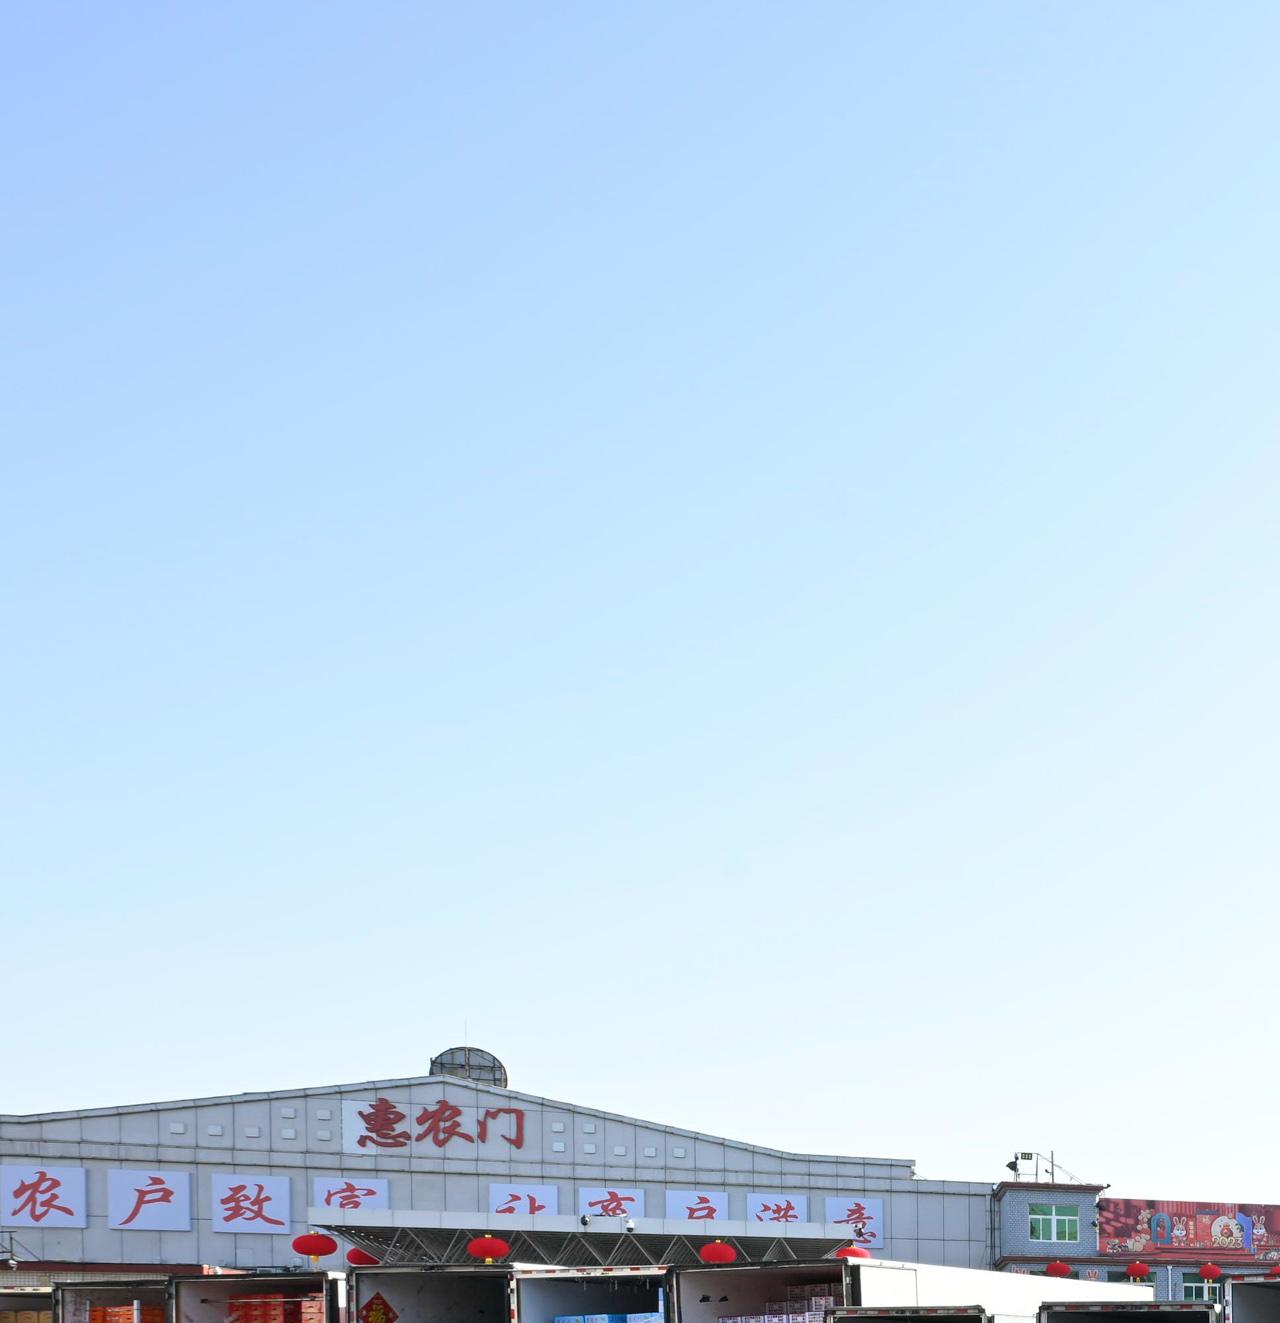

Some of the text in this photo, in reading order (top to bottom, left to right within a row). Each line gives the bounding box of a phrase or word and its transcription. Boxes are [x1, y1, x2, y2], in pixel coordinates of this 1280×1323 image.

[357, 1097, 524, 1149] 惠农门
[1212, 1237, 1243, 1248] 2023
